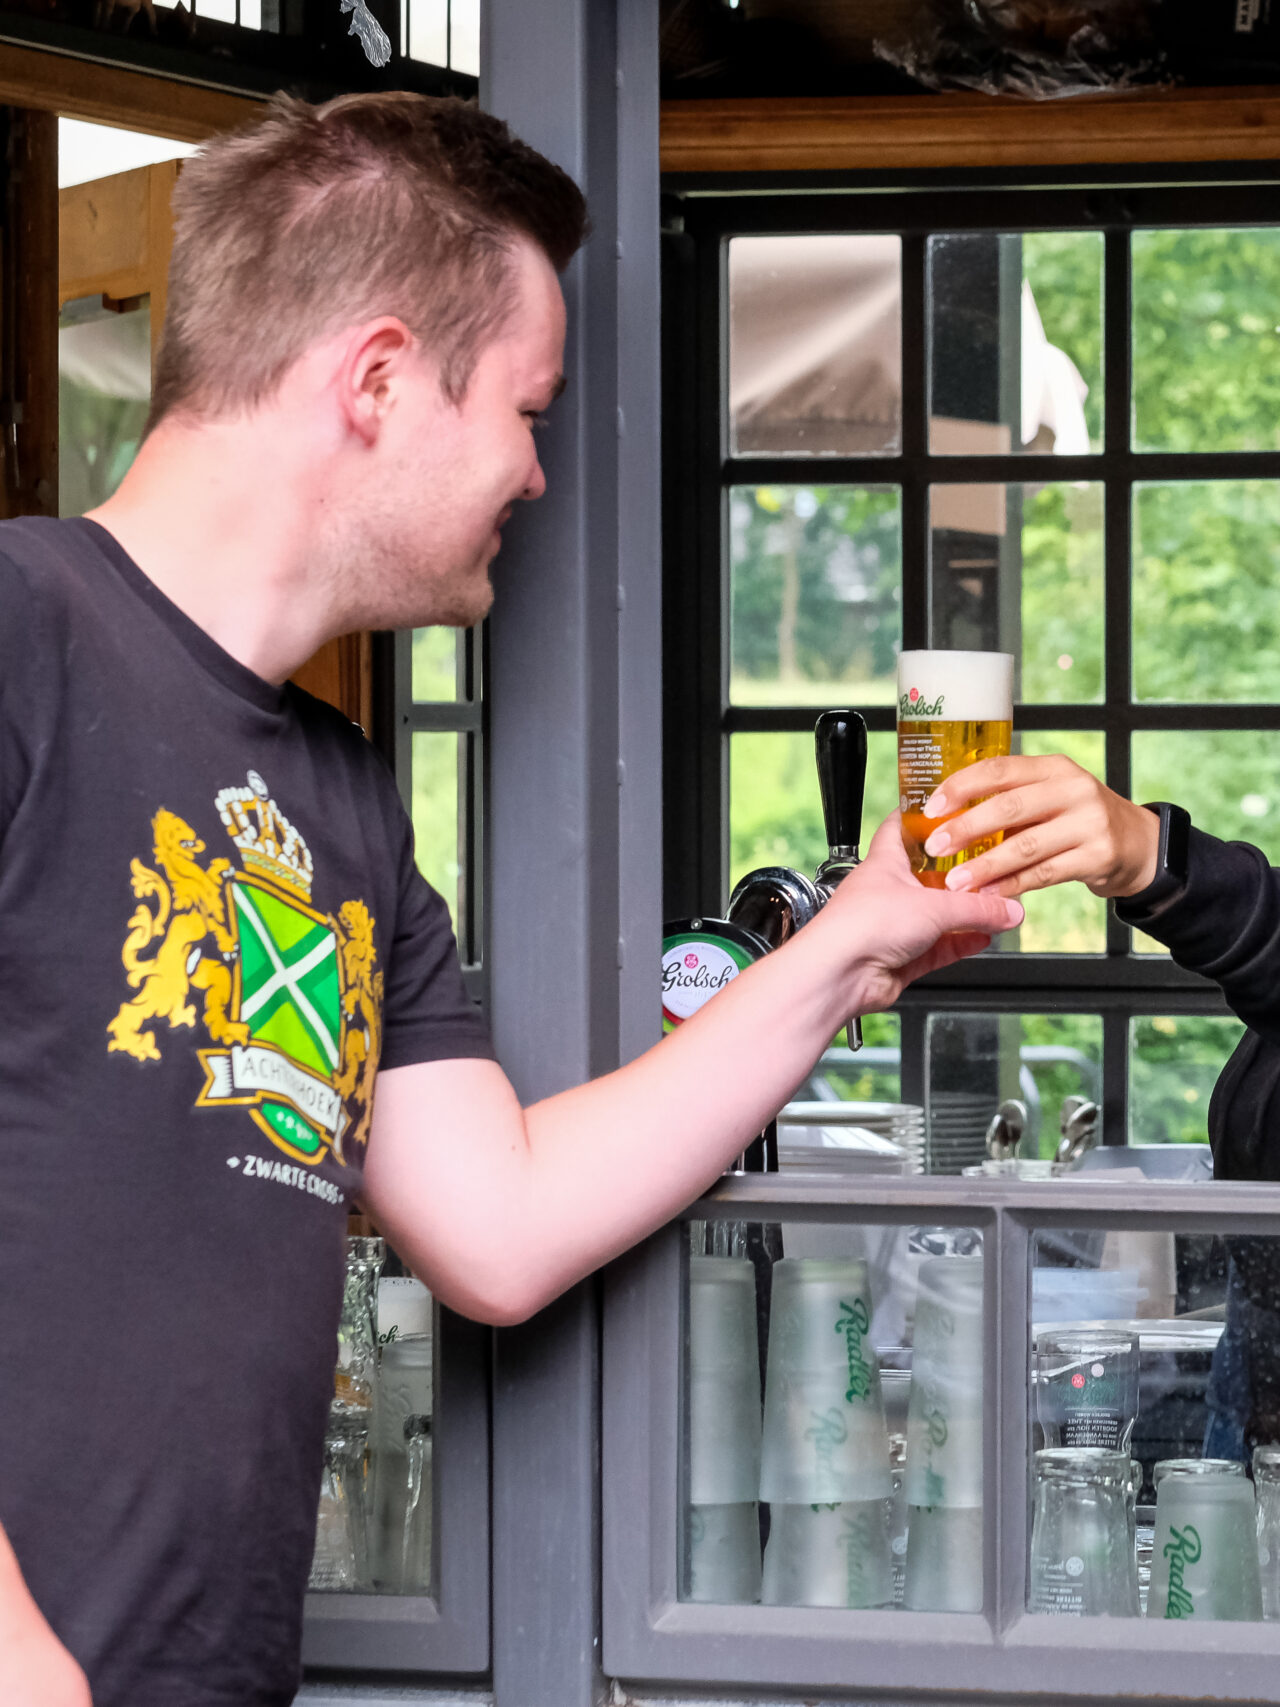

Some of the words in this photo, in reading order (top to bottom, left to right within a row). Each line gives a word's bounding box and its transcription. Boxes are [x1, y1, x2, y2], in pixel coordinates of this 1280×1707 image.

[899, 693, 945, 720] Grolsch
[662, 961, 733, 992] Grolsch
[241, 1057, 336, 1115] ACHTHOEK
[834, 1296, 874, 1404] Radler
[1163, 1524, 1202, 1619] Radle
